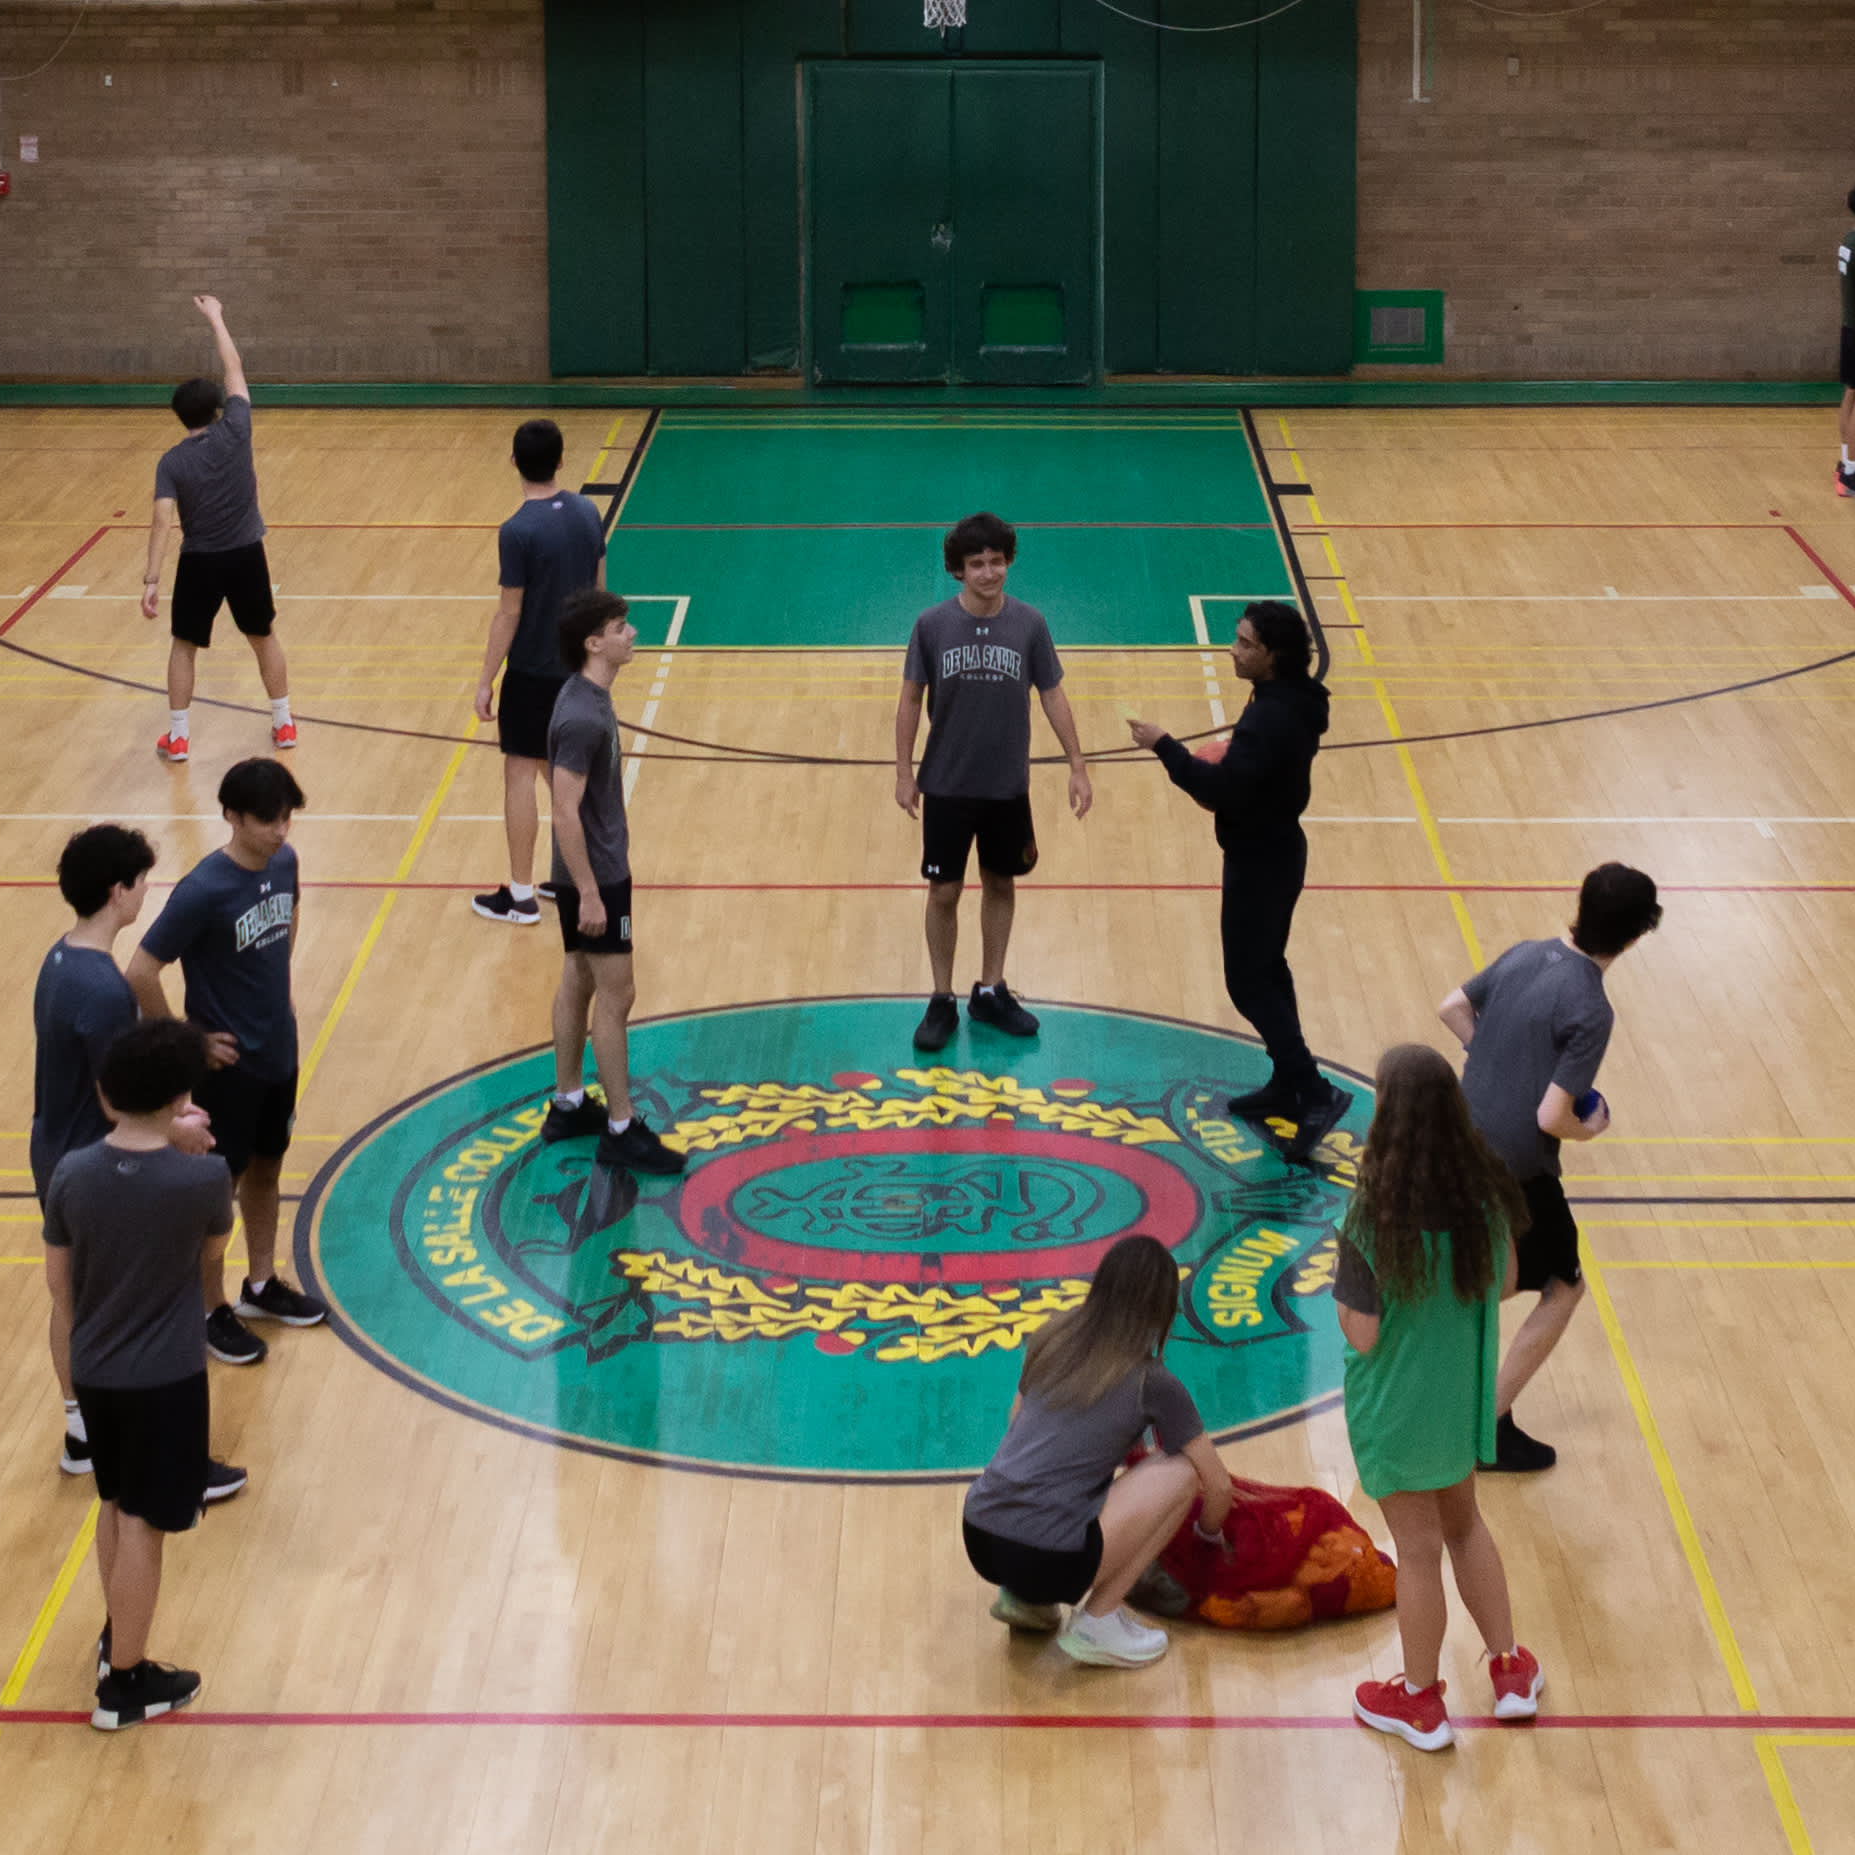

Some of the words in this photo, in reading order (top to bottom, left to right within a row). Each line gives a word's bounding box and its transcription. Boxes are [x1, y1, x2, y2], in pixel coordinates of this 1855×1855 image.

[943, 647, 961, 679] DE
[963, 644, 981, 671] LA
[983, 644, 1021, 681] SALLE
[443, 1083, 608, 1183] COLLE
[423, 1185, 479, 1266] SALLE
[442, 1264, 508, 1305] LA
[1208, 1228, 1300, 1327] SIGNUM
[480, 1299, 565, 1342] DE
